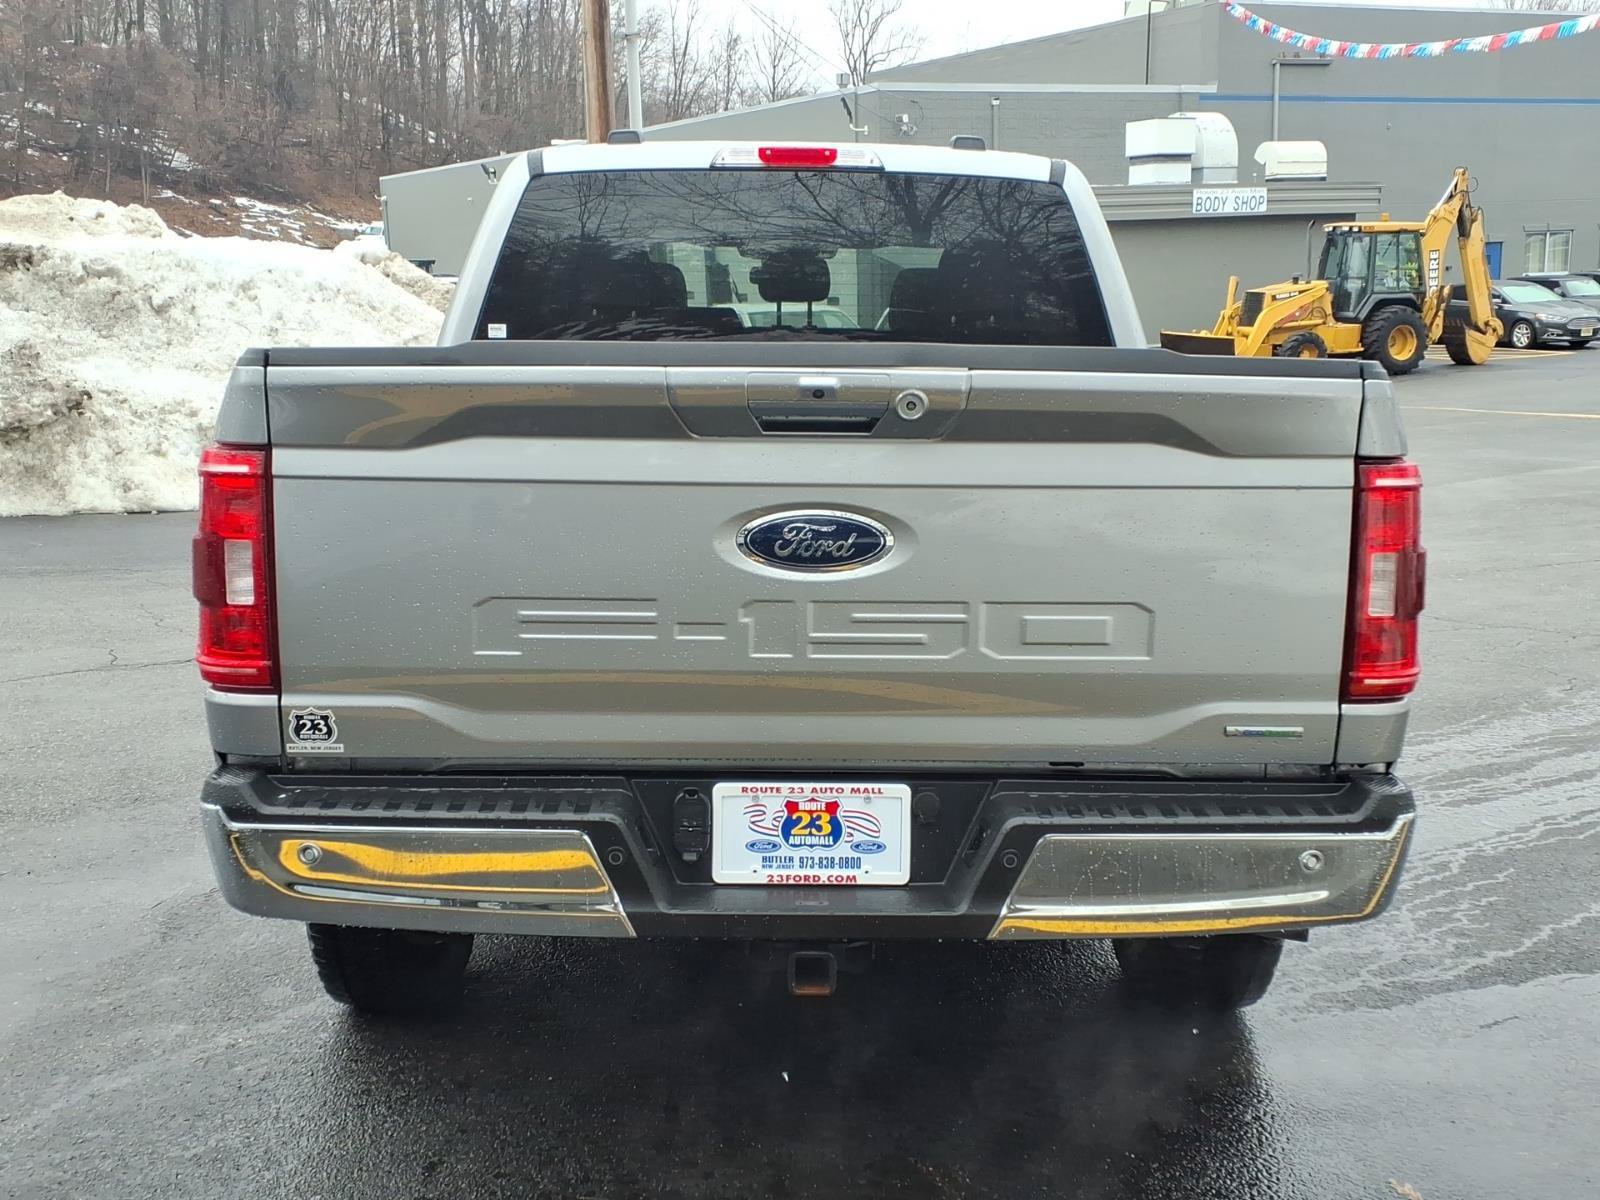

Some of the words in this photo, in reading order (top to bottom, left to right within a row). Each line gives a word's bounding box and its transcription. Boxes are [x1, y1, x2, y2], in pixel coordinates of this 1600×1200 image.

[1195, 196, 1228, 212] BODY
[1233, 195, 1265, 211] SHOP
[774, 523, 857, 557] Ford
[472, 597, 1155, 660] F-150
[299, 719, 328, 735] 23
[741, 786, 782, 794] ROUTE
[850, 787, 884, 795] MALL
[798, 802, 827, 811] ROUTE
[791, 812, 833, 836] 23
[752, 841, 774, 849] Ford
[788, 836, 834, 846] AUTOMALL
[857, 842, 879, 850] Ford
[761, 855, 794, 864] BUTLER
[799, 856, 862, 870] 973-838-0800
[766, 874, 857, 884] 23FORD.COM
